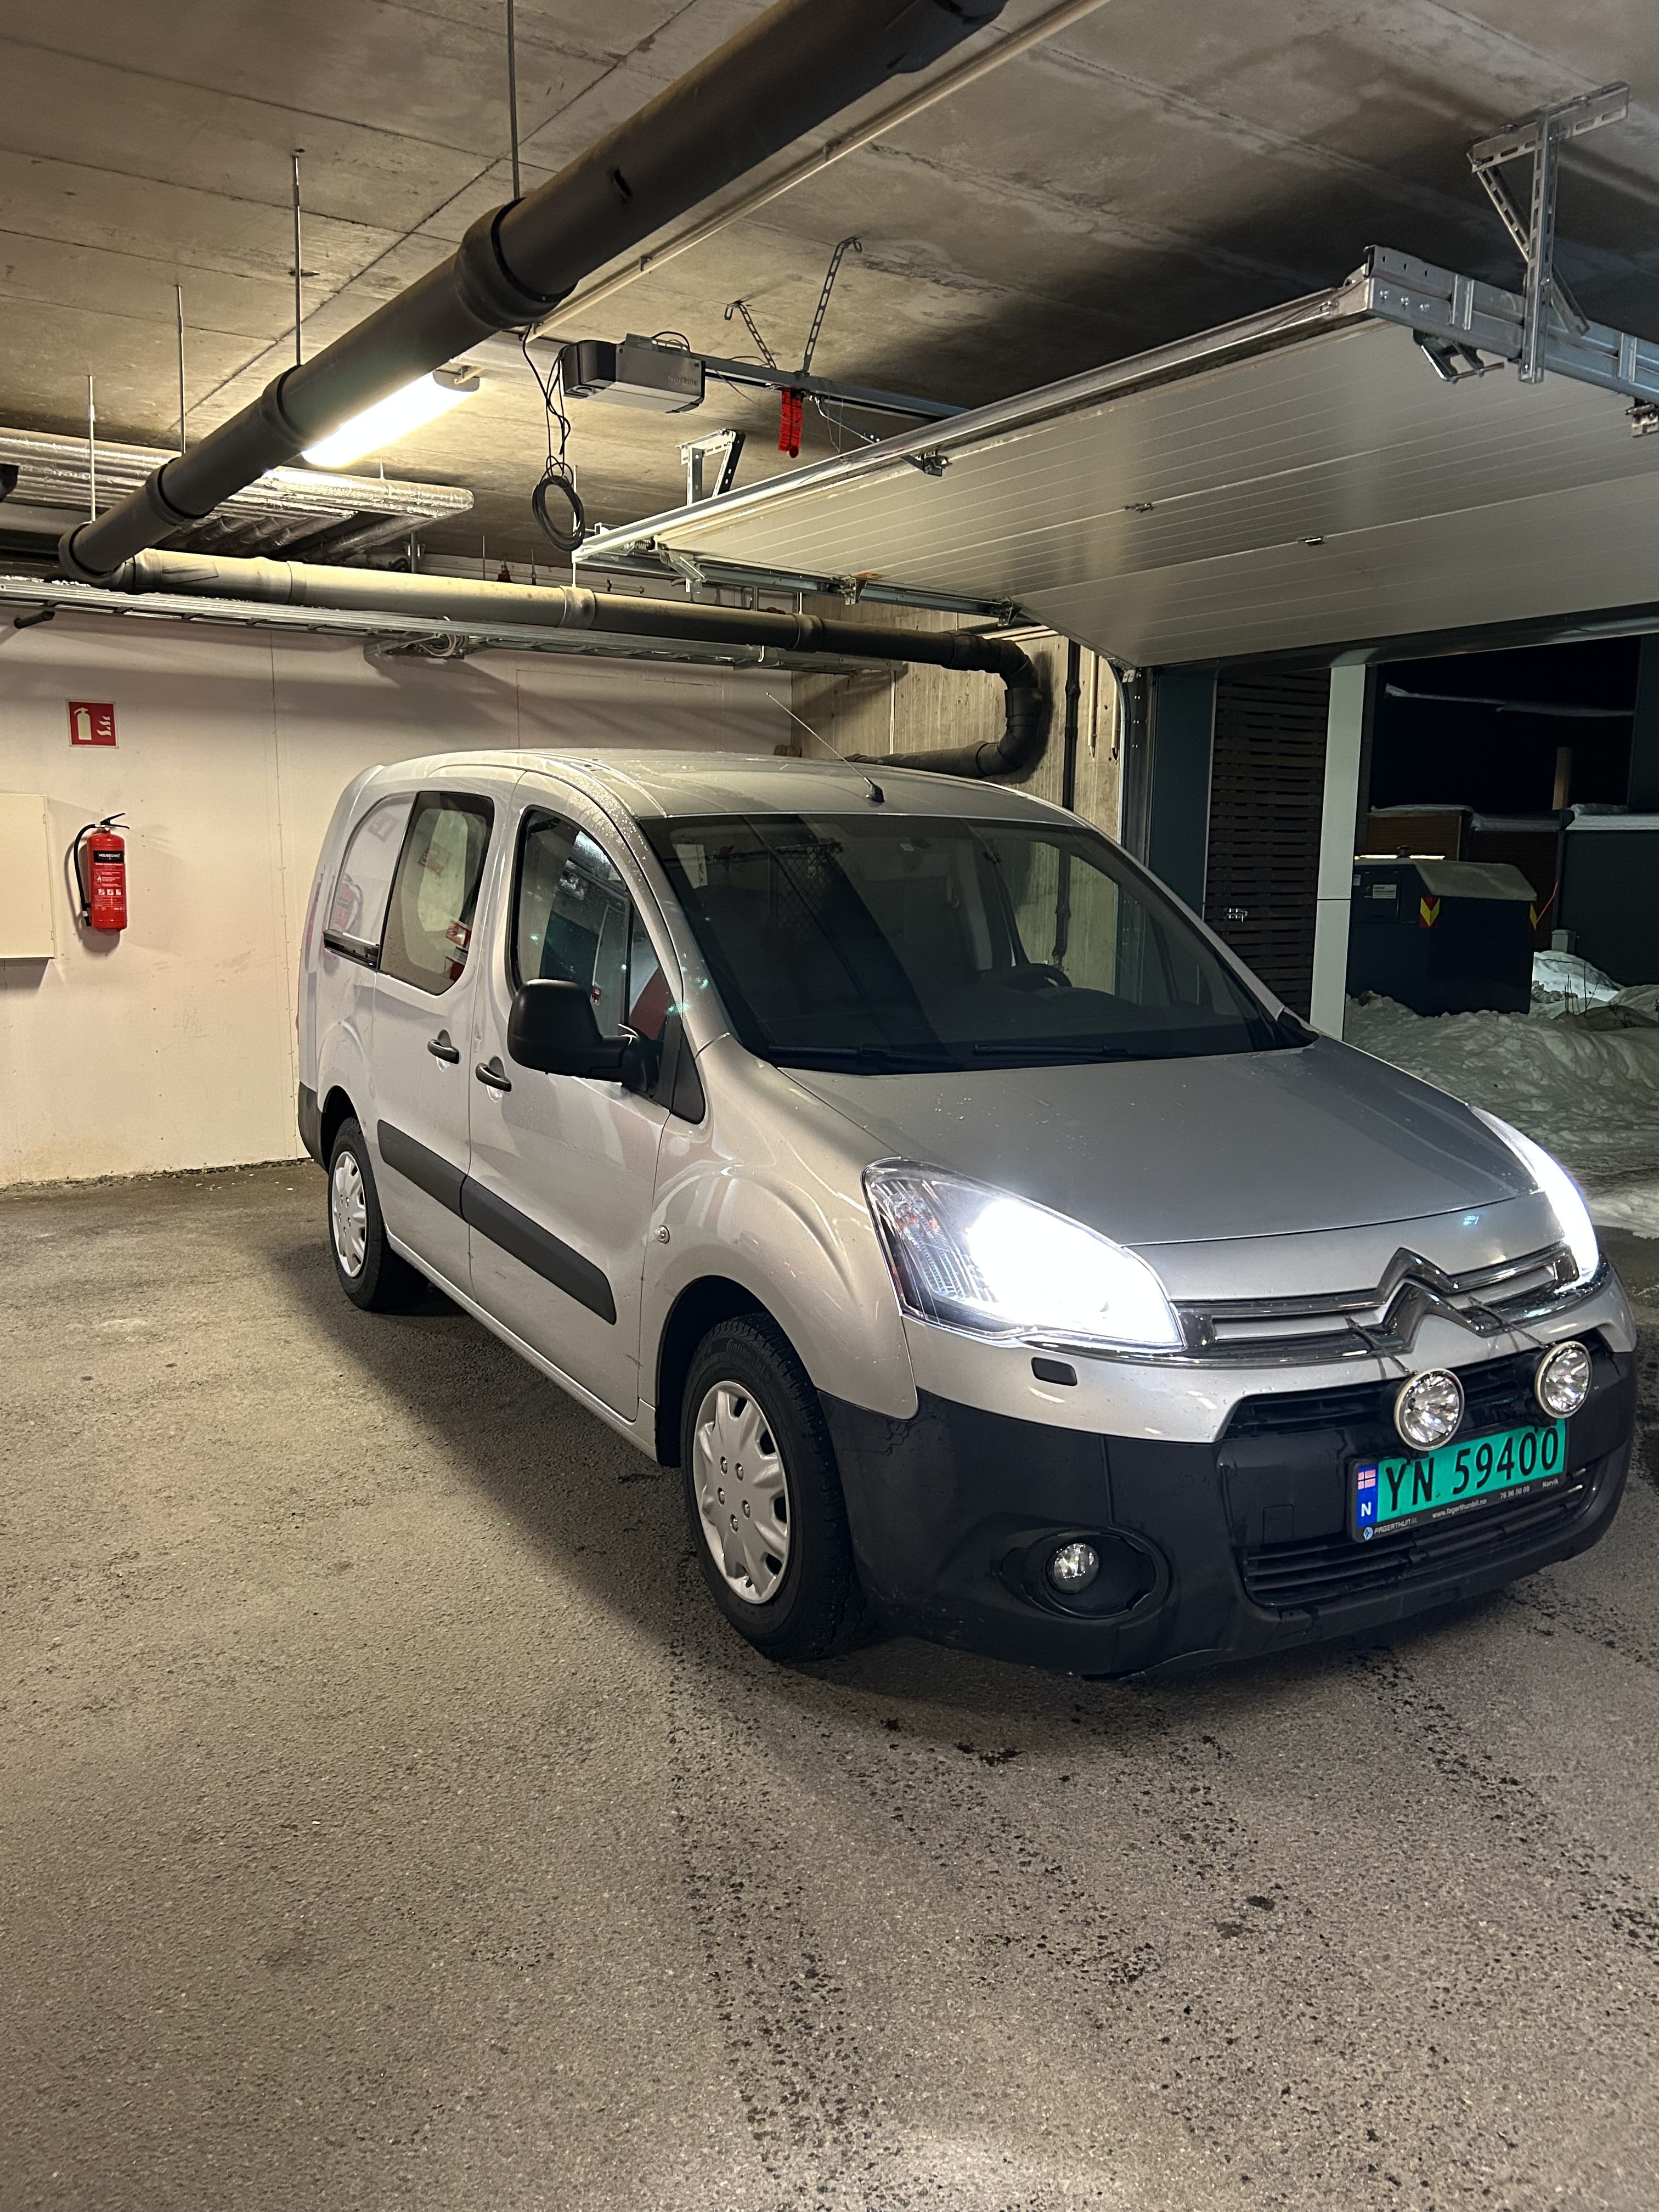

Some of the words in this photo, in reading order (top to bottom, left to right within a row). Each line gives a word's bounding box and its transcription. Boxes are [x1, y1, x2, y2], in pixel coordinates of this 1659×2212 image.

[1385, 1457, 1434, 1511] YN
[1452, 1427, 1559, 1495] 59400
[1542, 1478, 1559, 1488] Narvik
[1361, 1502, 1372, 1517] N
[1432, 1498, 1487, 1519] www.fagerthunbil.no
[1374, 1519, 1411, 1534] FAGERTHUN
